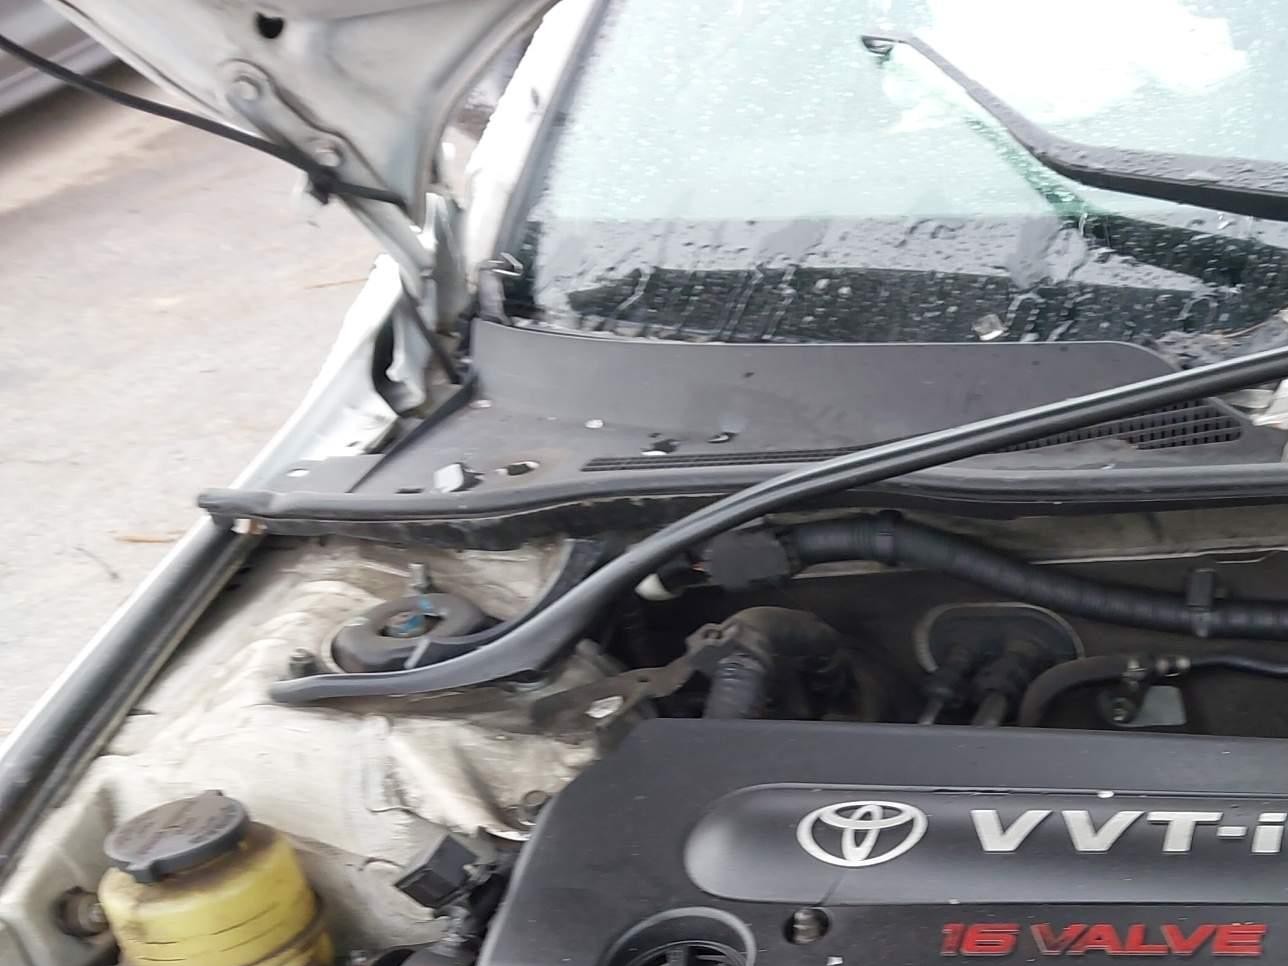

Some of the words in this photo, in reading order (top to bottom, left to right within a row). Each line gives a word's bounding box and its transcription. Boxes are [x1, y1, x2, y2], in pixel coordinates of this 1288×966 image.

[970, 809, 1288, 854] VVT-i
[941, 923, 1021, 956] 16
[1029, 923, 1268, 956] VALVE
